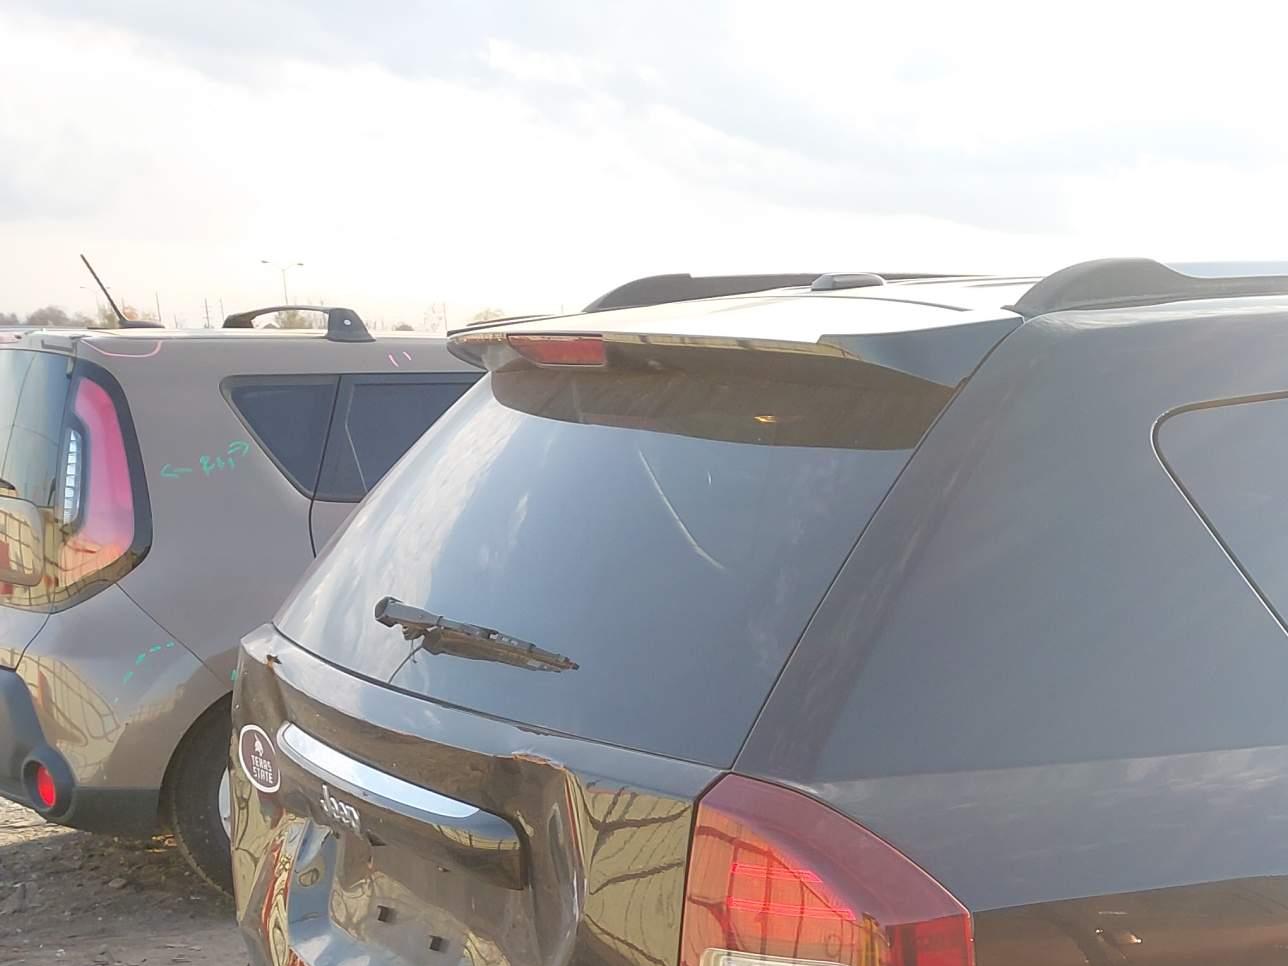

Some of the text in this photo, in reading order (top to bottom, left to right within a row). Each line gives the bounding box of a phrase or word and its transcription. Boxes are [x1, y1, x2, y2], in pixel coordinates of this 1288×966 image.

[251, 754, 272, 772] TEXAS
[253, 766, 273, 784] STATE
[320, 784, 359, 828] Jeep
